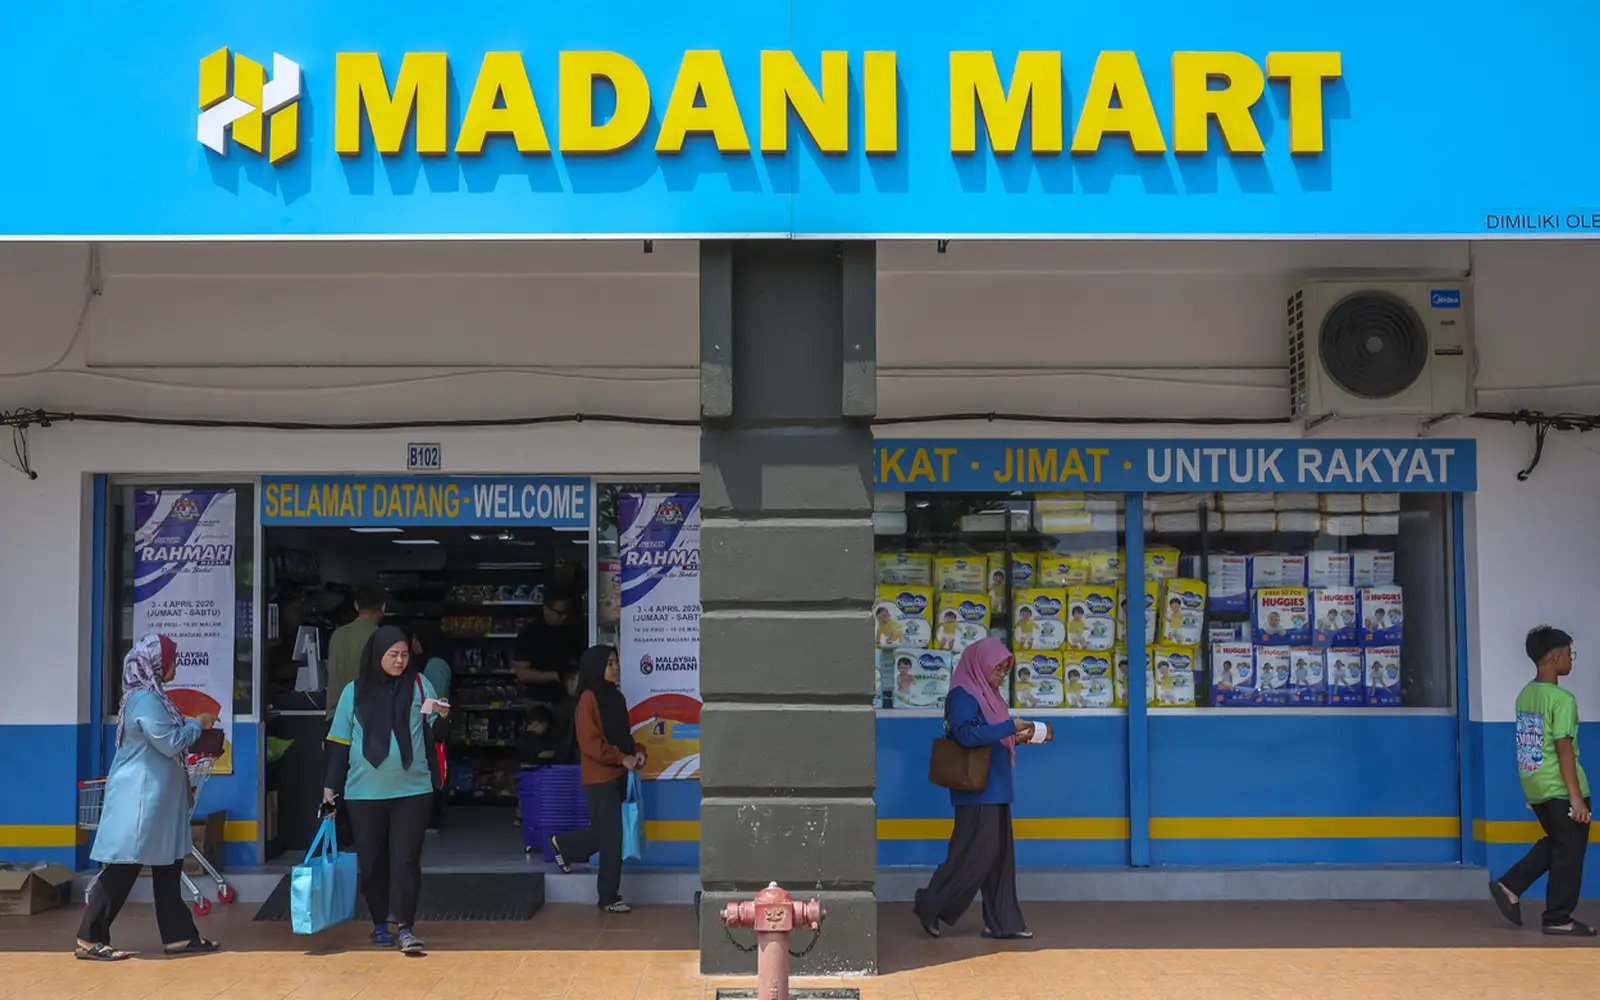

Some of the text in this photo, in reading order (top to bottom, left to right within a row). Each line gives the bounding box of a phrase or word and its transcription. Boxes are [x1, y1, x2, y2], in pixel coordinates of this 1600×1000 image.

[335, 49, 1342, 155] MADANI MART
[1486, 213, 1600, 229] DIMILIKI OLE
[410, 447, 438, 466] B102
[873, 447, 1455, 484] KAT JIMAT UNTUK RAKYAT
[265, 483, 584, 519] SELAMAT DATANG WELCOME
[141, 544, 232, 562] RAHMAH
[1324, 593, 1354, 601] HUGGIES
[1371, 593, 1401, 601] HUGGIES
[169, 600, 194, 608] APRIL
[195, 600, 215, 608] 2026
[1262, 597, 1305, 607] HUGGIES
[147, 609, 182, 618] (JUMAAT
[189, 609, 221, 617] SABTU)
[633, 613, 668, 622] (JUMAAT
[676, 613, 701, 621] SABT
[176, 658, 209, 666] ADANI
[655, 663, 698, 671] MADANI
